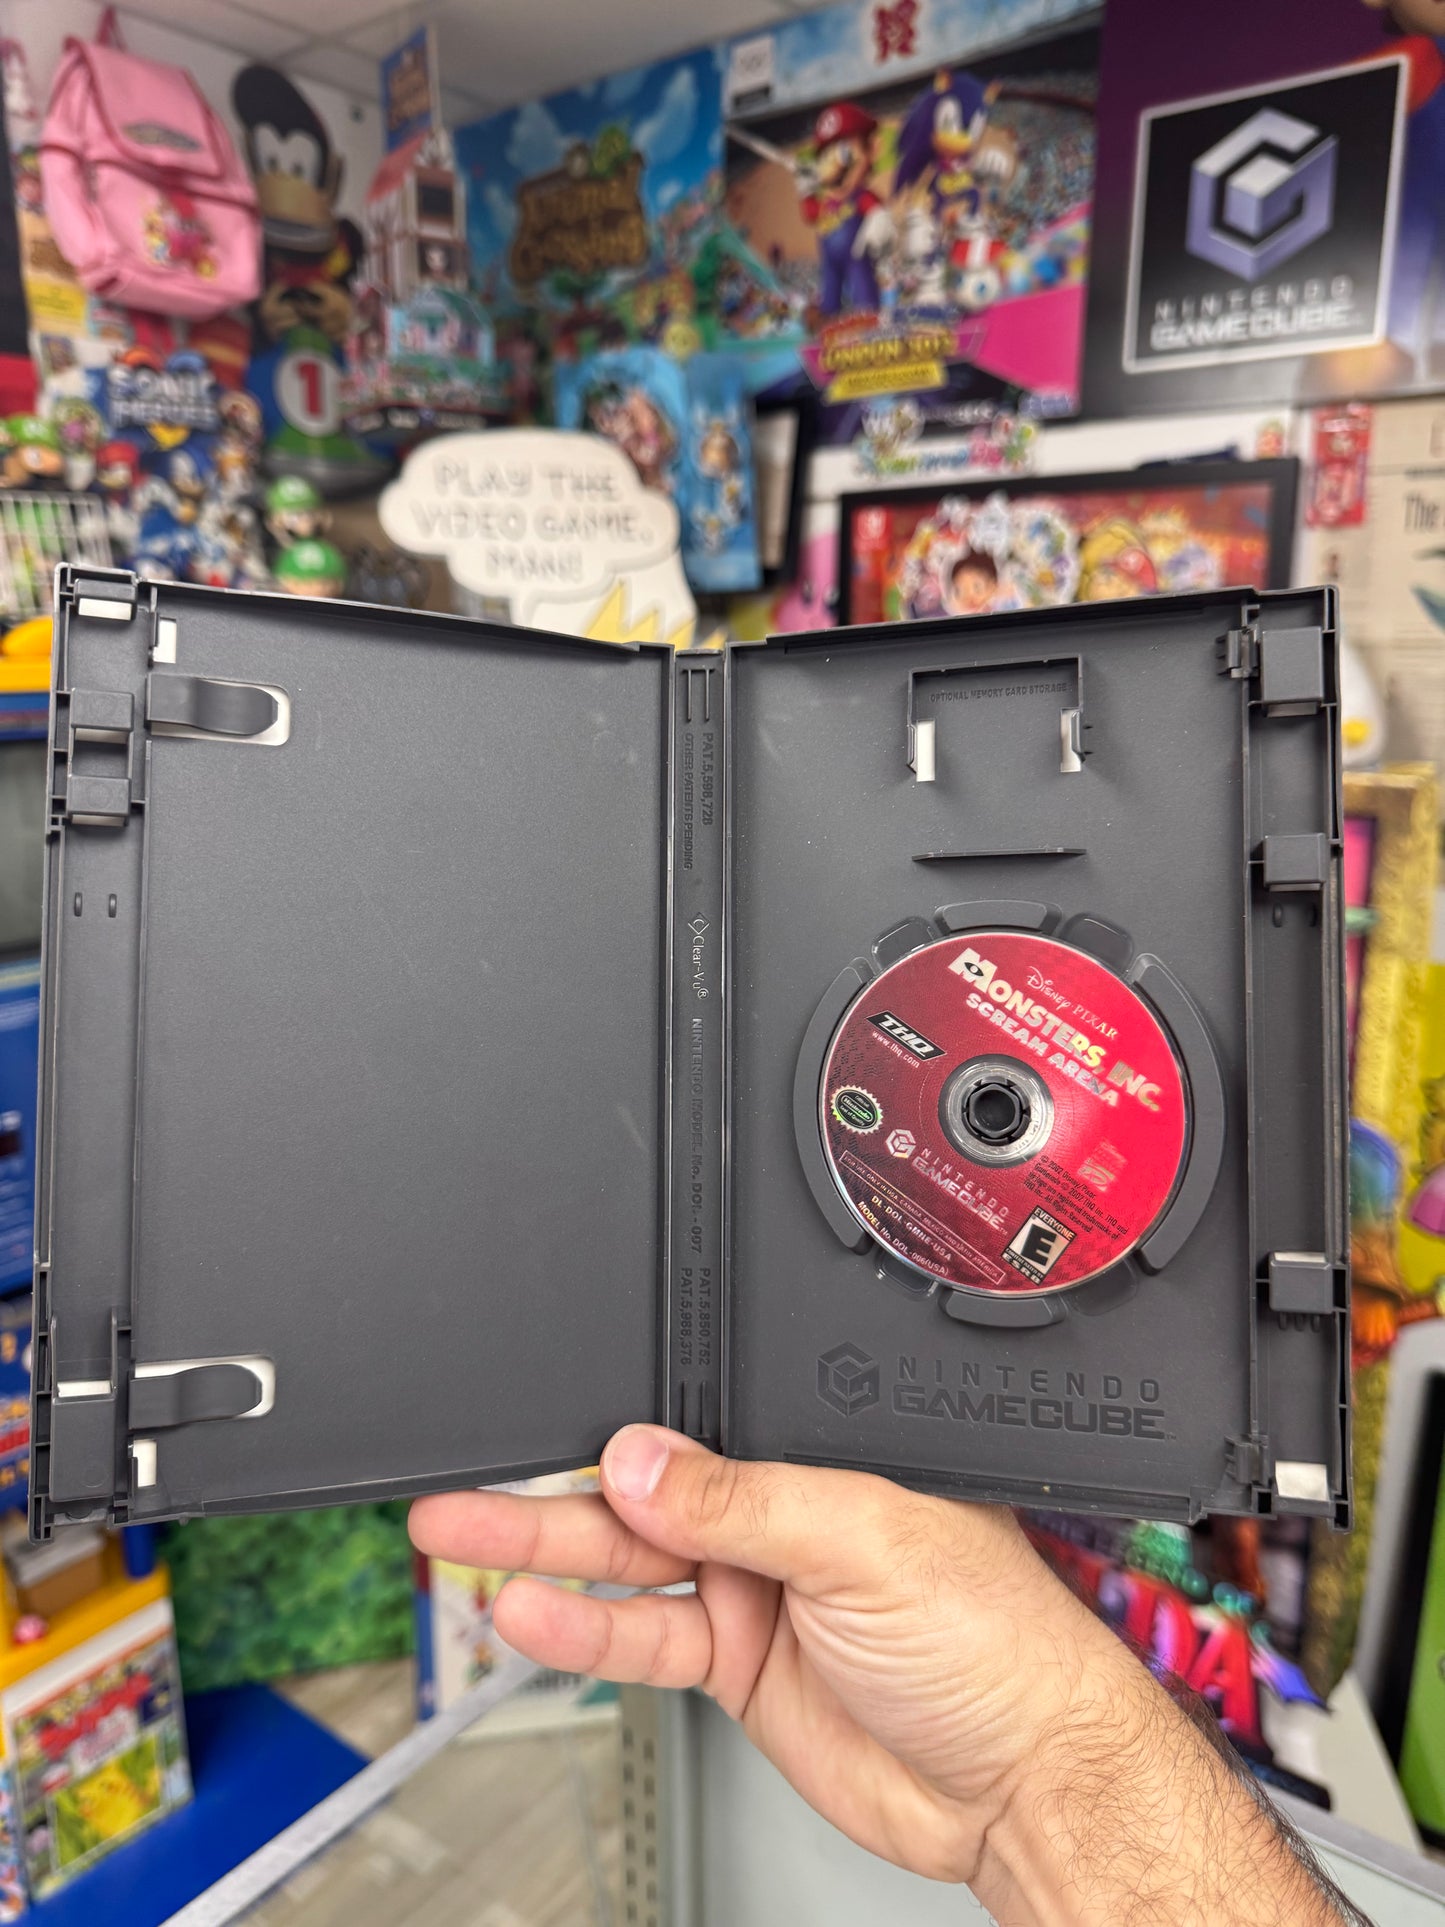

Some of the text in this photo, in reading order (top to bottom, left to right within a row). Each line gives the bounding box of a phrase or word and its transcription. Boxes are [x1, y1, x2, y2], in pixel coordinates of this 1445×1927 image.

[432, 455, 617, 500] PLAY THE
[408, 503, 528, 541] VIDEO
[930, 682, 1068, 703] OPTIONAL MEMORY CARD STORAGE
[683, 733, 694, 870] OTHER PATENTS PENDING
[692, 1018, 704, 1094] NINTENDO
[872, 1031, 920, 1069] www.thq.com
[878, 1014, 935, 1058] THQ
[965, 993, 1120, 1107] SCREAM ARENA
[1106, 1060, 1161, 1113] INC.
[692, 1098, 704, 1152] MODEL
[922, 1148, 1009, 1217] NINTENDO
[857, 1201, 881, 1230] MODEL
[880, 1226, 892, 1242] No.
[1033, 1207, 1075, 1240] EVERYONE
[1055, 1191, 1083, 1215] registered
[1081, 1210, 1113, 1236] trademarks
[1068, 1187, 1084, 1202] 2002
[1082, 1198, 1096, 1211] THQ
[1104, 1214, 1118, 1227] THQ
[1021, 1224, 1057, 1266] E
[1001, 1252, 1040, 1285] ESRB
[897, 1355, 1160, 1404] NINTENDO
